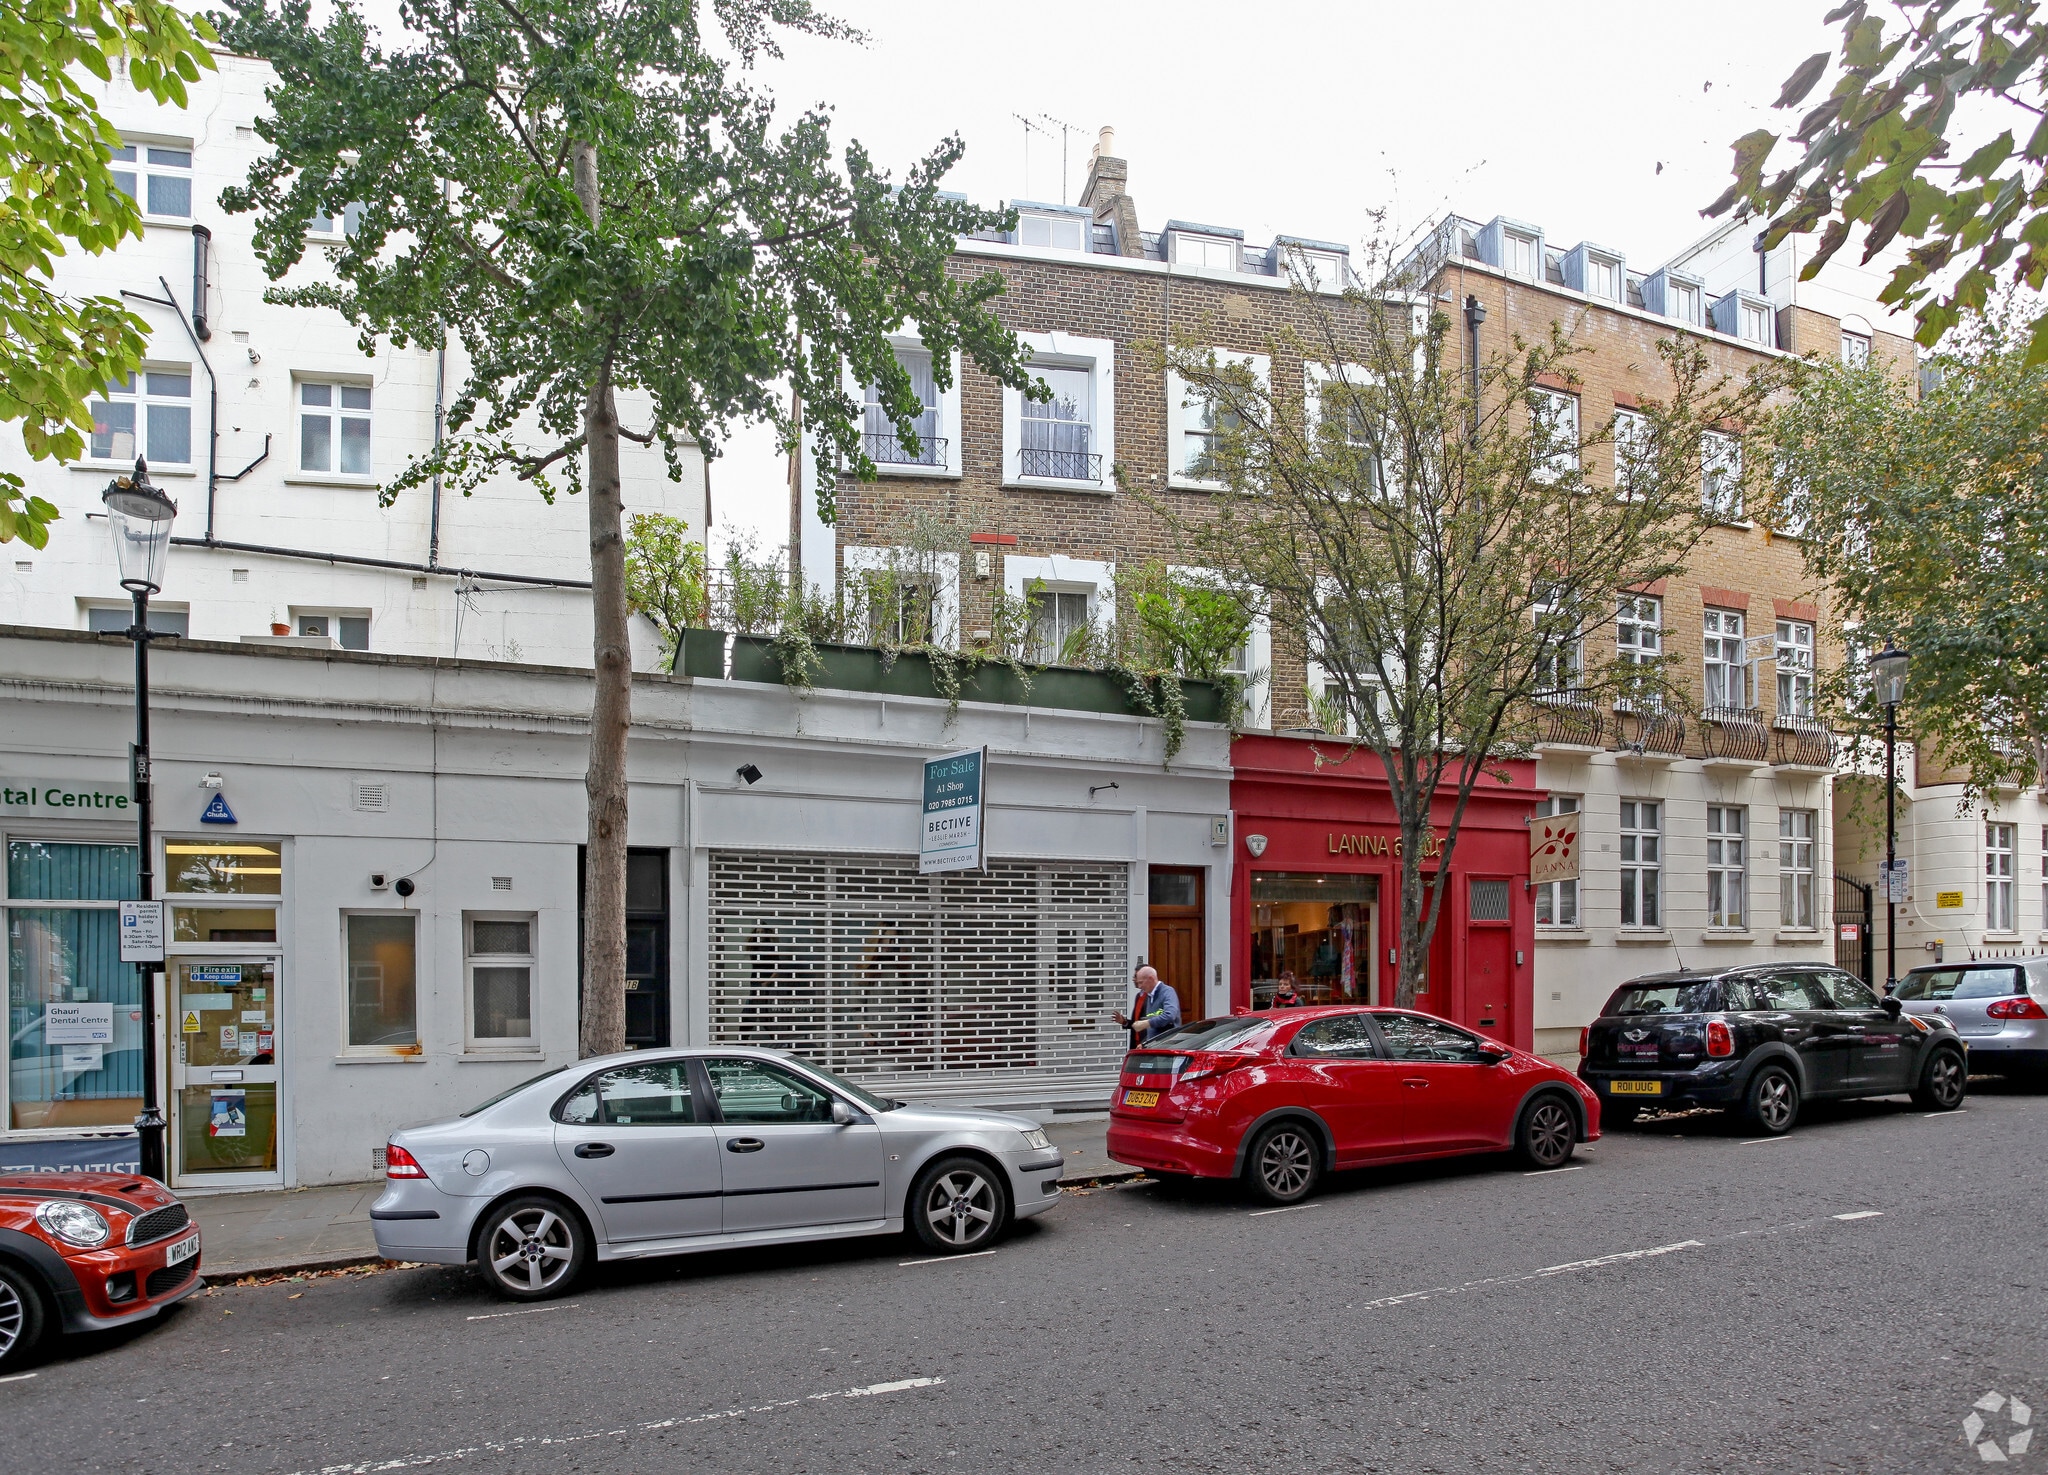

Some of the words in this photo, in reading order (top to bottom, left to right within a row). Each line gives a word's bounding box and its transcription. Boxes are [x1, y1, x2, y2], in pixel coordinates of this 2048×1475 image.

[930, 765, 949, 780] For
[951, 758, 975, 775] Sale
[947, 781, 964, 791] Shop
[0, 787, 37, 806] tal
[45, 788, 129, 809] Centre
[928, 801, 940, 810] 020
[941, 798, 956, 808] 7985
[957, 795, 973, 804] 0715
[928, 816, 971, 833] BECTIVE
[1329, 833, 1390, 855] LANNA
[924, 854, 973, 866] WWW.BECTIVE.CO.UK
[1535, 861, 1574, 874] LANNA
[125, 915, 135, 926] P
[51, 1007, 80, 1015] Ghauri
[81, 1016, 109, 1024] Centre
[1635, 1082, 1653, 1091] UUG
[171, 1241, 187, 1262] WR12
